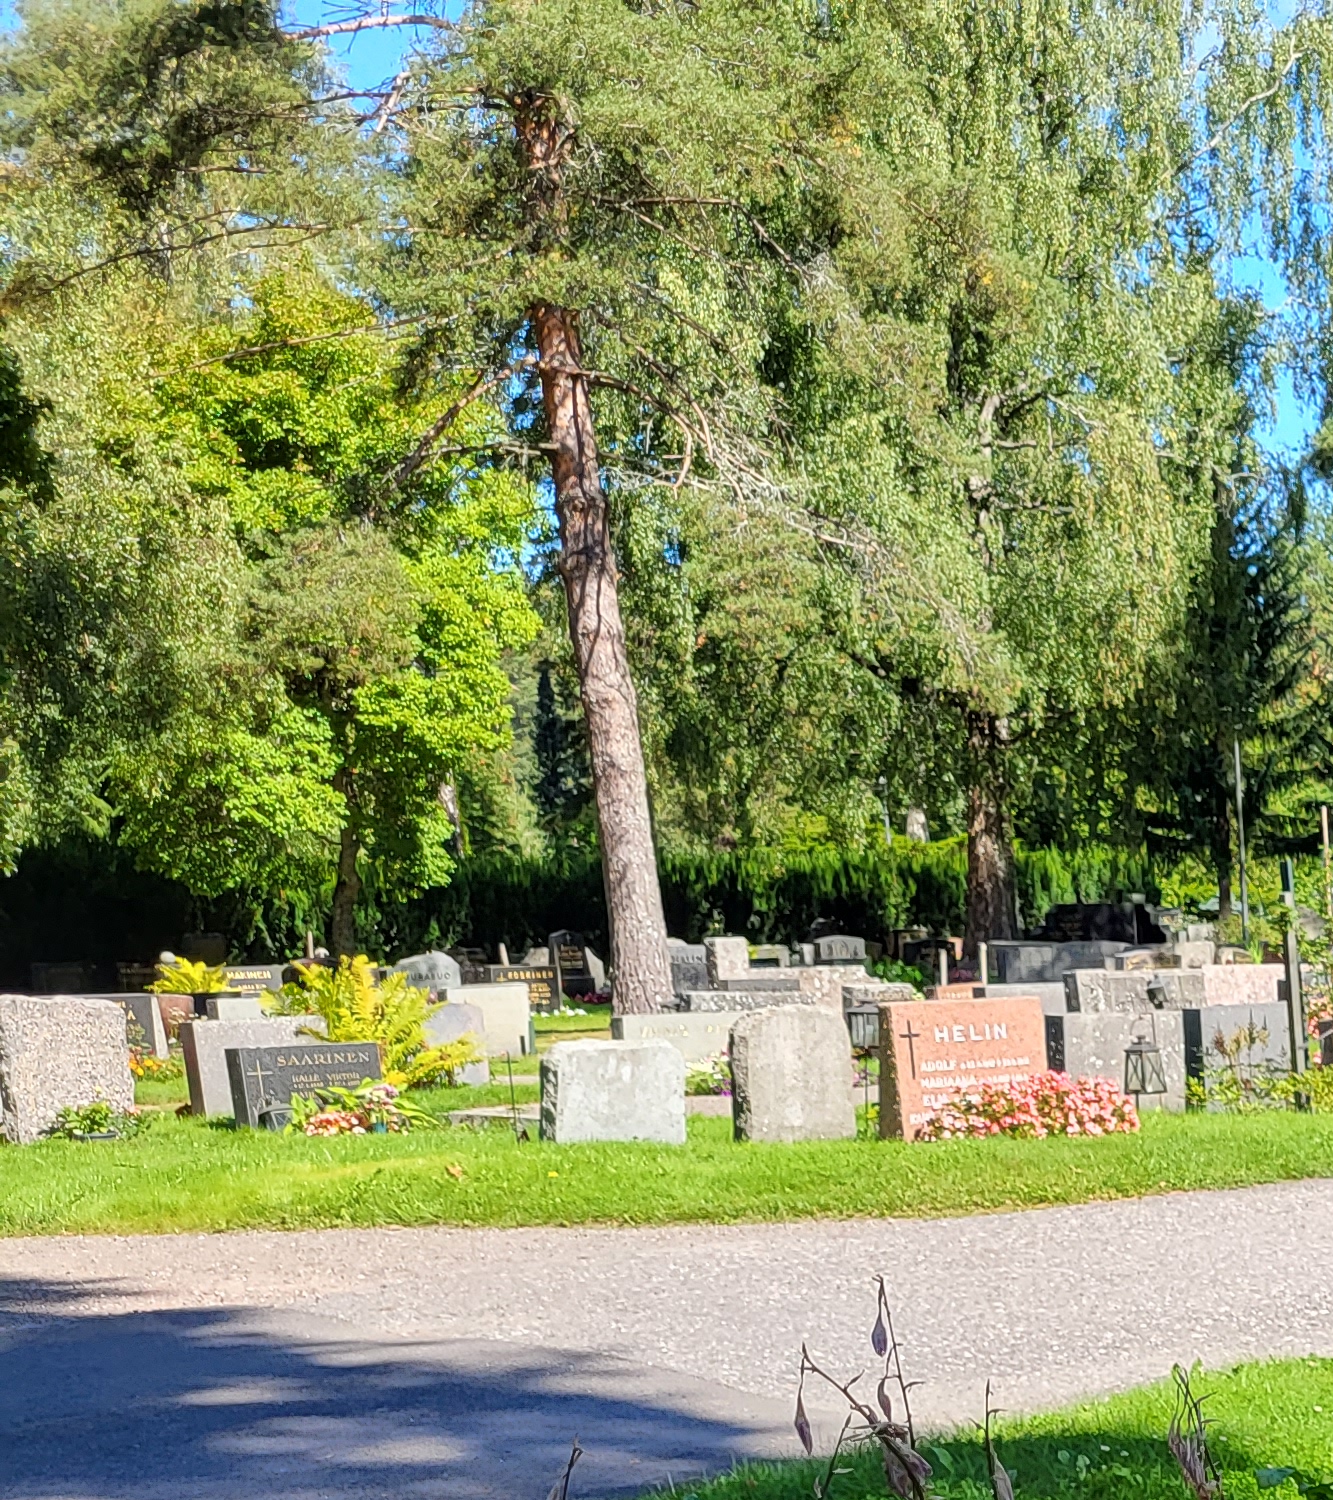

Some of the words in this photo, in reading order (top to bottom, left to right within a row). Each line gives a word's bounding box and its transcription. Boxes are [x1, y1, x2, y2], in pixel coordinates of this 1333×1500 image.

[933, 1022, 1008, 1043] HELIN
[276, 1051, 370, 1067] SAARINEN
[920, 1059, 957, 1072] ADOLF
